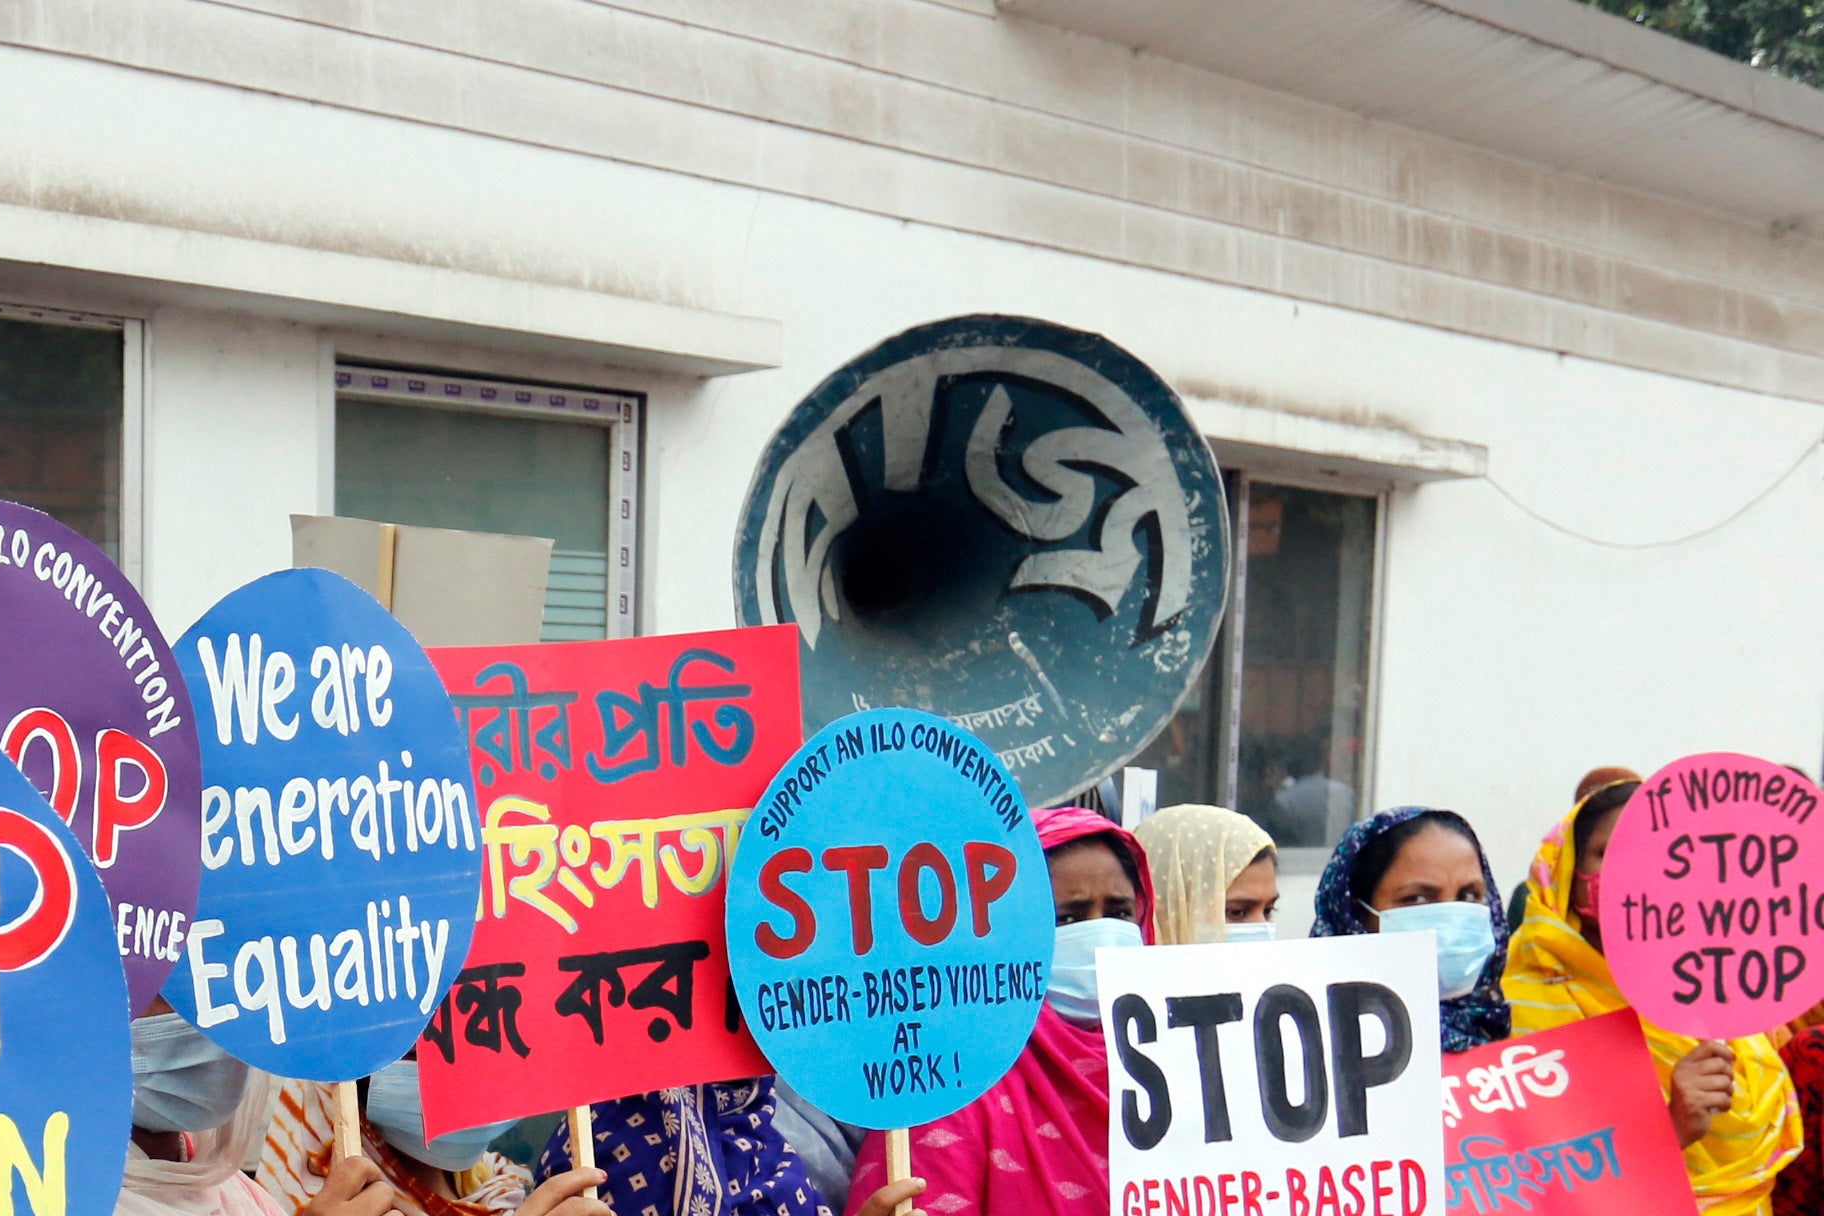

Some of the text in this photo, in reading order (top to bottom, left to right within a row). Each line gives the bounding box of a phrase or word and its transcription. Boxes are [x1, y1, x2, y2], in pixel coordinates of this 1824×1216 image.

[34, 542, 181, 738] CONVENTION
[197, 632, 394, 746] We are
[585, 648, 755, 784] প্রতি
[760, 723, 1024, 842] SUPPORT AN ILO CONVENTION
[754, 841, 1018, 960] STOP
[1622, 893, 1686, 942] the
[1663, 833, 1799, 888] STOP
[186, 895, 450, 1045] Equality
[757, 960, 1044, 1033] GENDER-BASED VIOLENCE
[1672, 944, 1807, 1006] STOP
[893, 1022, 922, 1054] AT
[1112, 980, 1413, 1151] STOP
[1466, 1044, 1570, 1114] প্রতি
